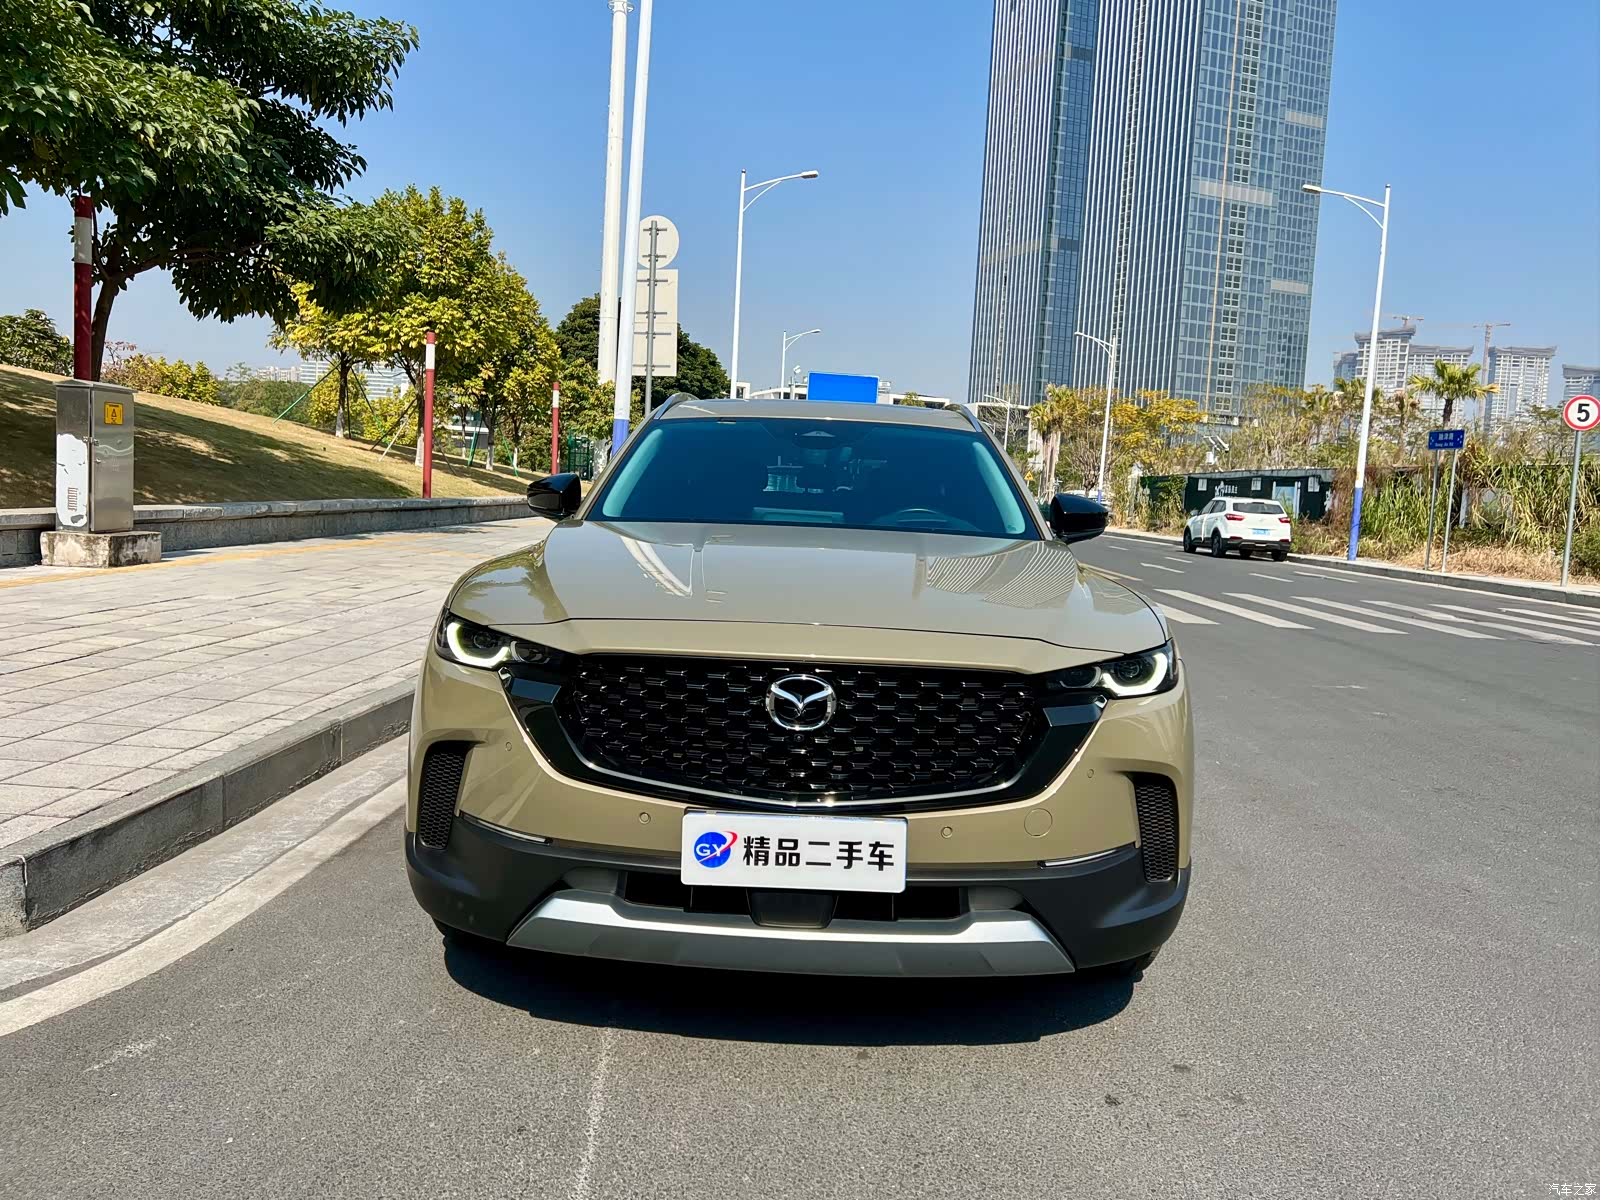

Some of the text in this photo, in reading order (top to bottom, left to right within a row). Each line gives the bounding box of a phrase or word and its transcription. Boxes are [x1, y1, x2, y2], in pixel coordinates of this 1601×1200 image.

[1577, 403, 1591, 422] 5
[695, 843, 726, 857] GY
[743, 835, 895, 871] 精品二手车
